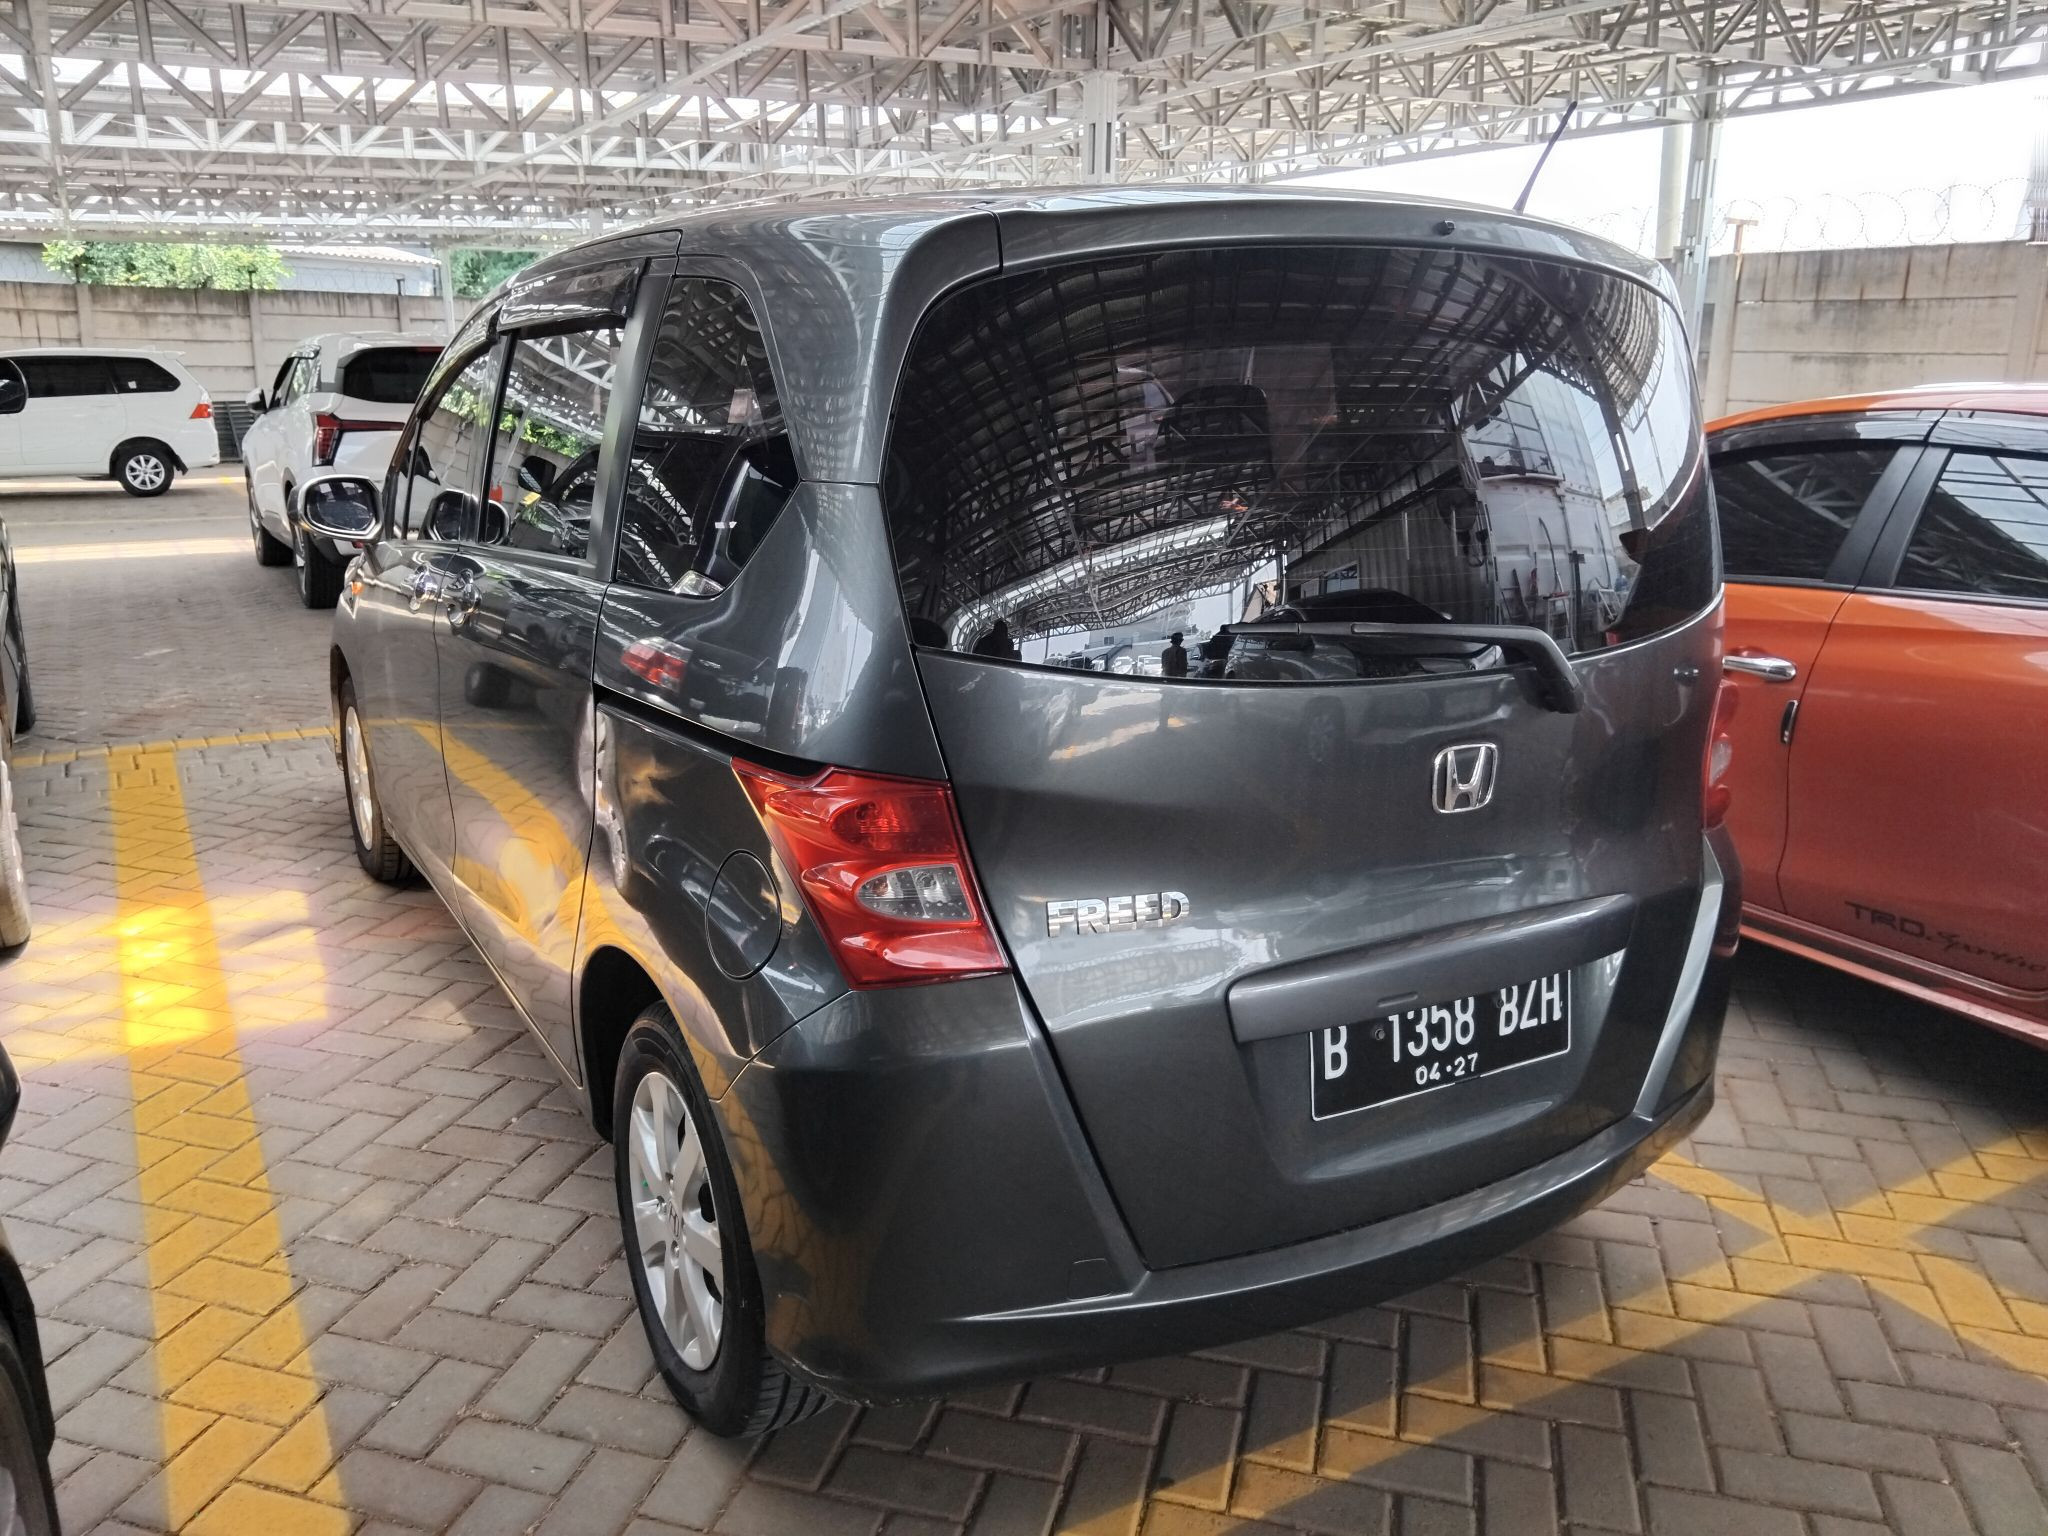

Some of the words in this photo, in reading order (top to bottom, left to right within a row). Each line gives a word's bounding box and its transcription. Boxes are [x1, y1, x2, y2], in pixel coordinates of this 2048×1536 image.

[1046, 891, 1190, 938] FREED
[1323, 1025, 1349, 1081] B
[1387, 996, 1476, 1063] 1358
[1498, 973, 1563, 1037] BZH
